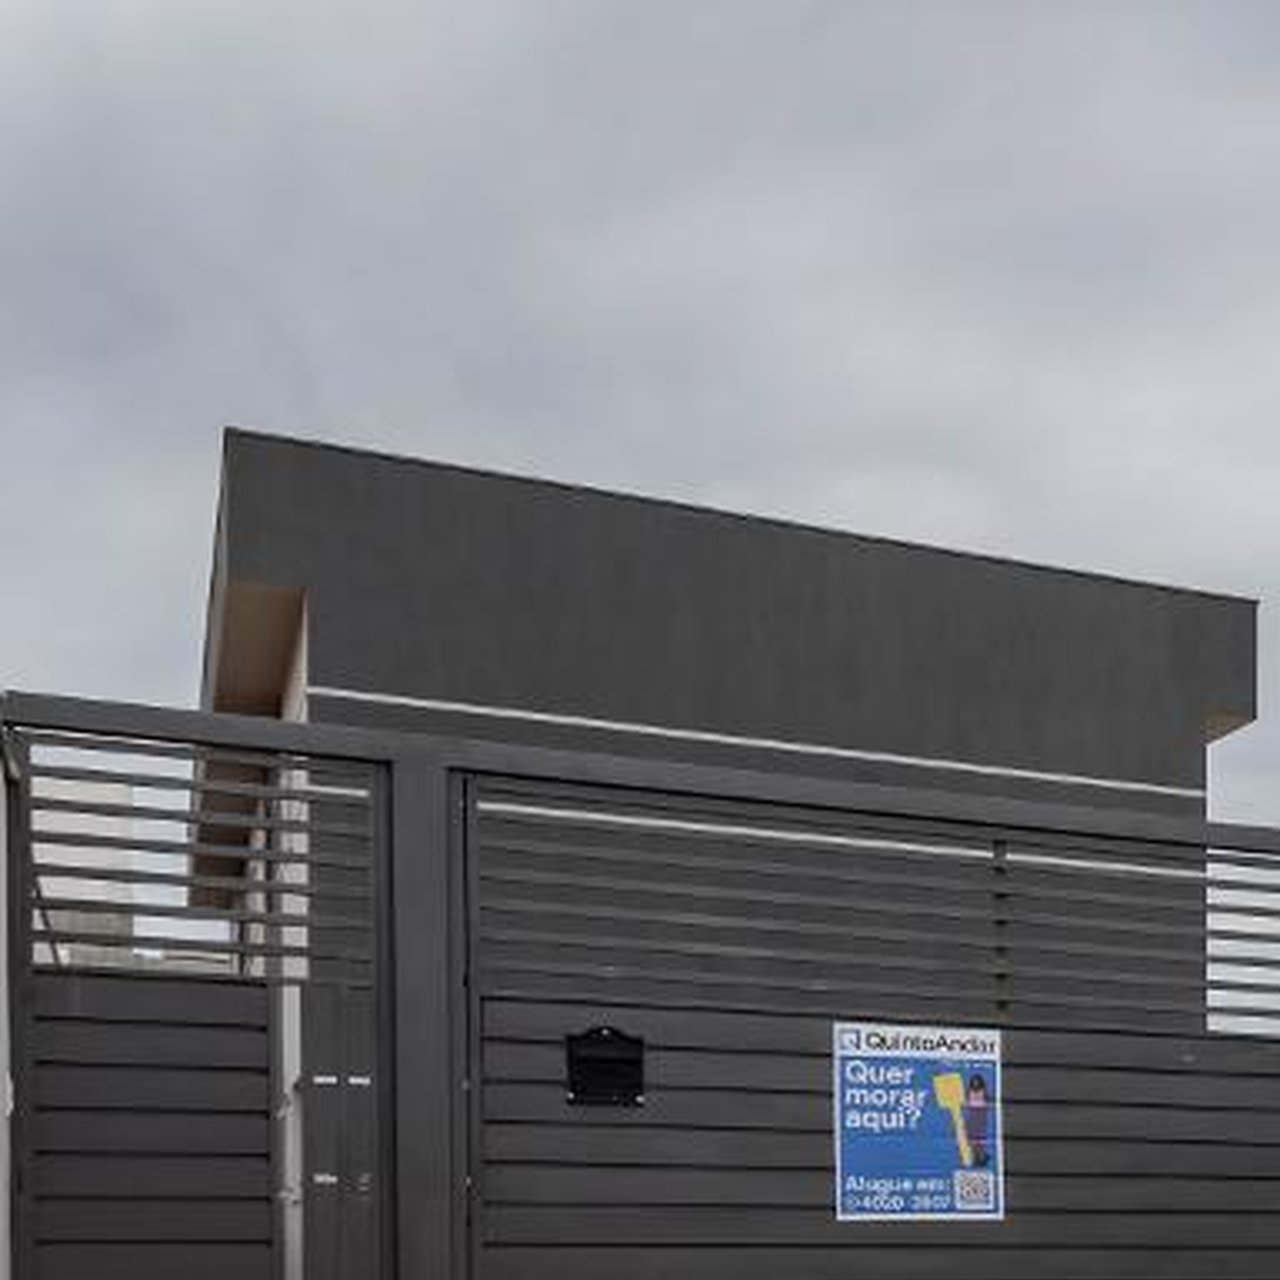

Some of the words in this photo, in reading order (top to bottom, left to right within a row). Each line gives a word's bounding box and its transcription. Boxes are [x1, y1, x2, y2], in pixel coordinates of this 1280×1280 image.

[865, 1031, 996, 1053] QuintoAndar
[845, 1060, 914, 1085] Quer
[845, 1088, 928, 1108] morar
[845, 1107, 922, 1132] aqui?
